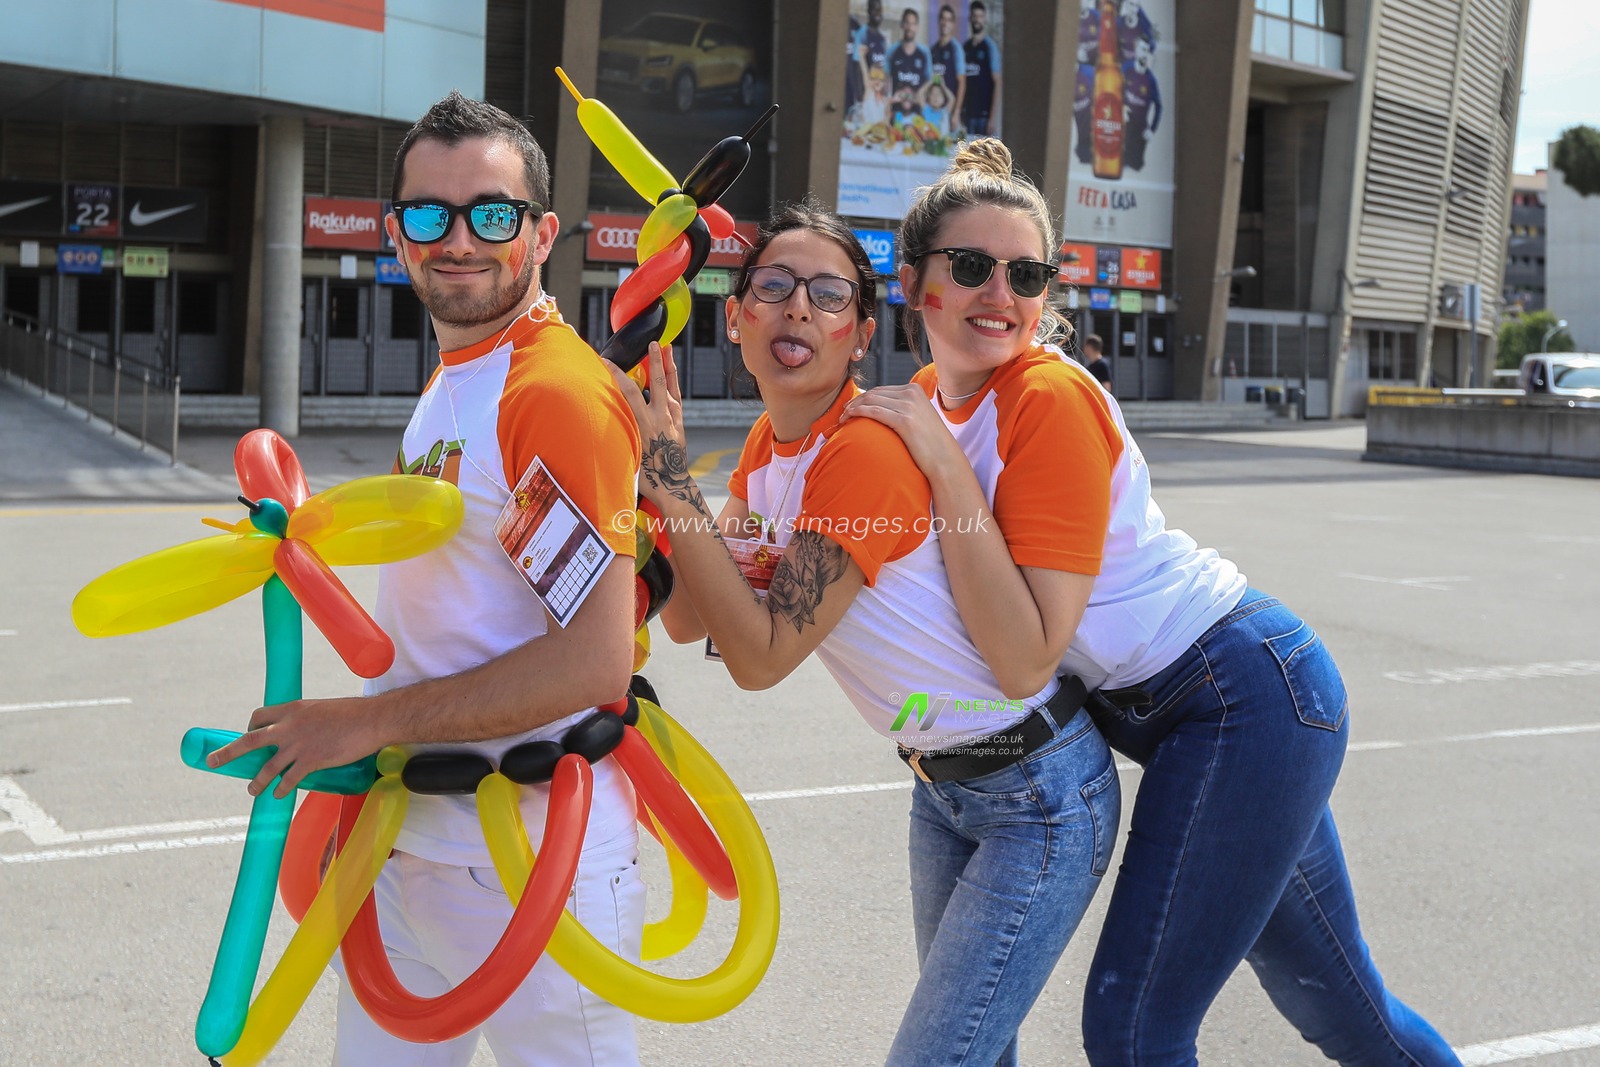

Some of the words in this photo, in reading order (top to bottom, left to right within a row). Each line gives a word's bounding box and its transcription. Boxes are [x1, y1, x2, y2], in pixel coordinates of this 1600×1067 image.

[1111, 188, 1137, 210] CASA
[76, 202, 110, 226] 22
[309, 211, 377, 232] Rakuten
